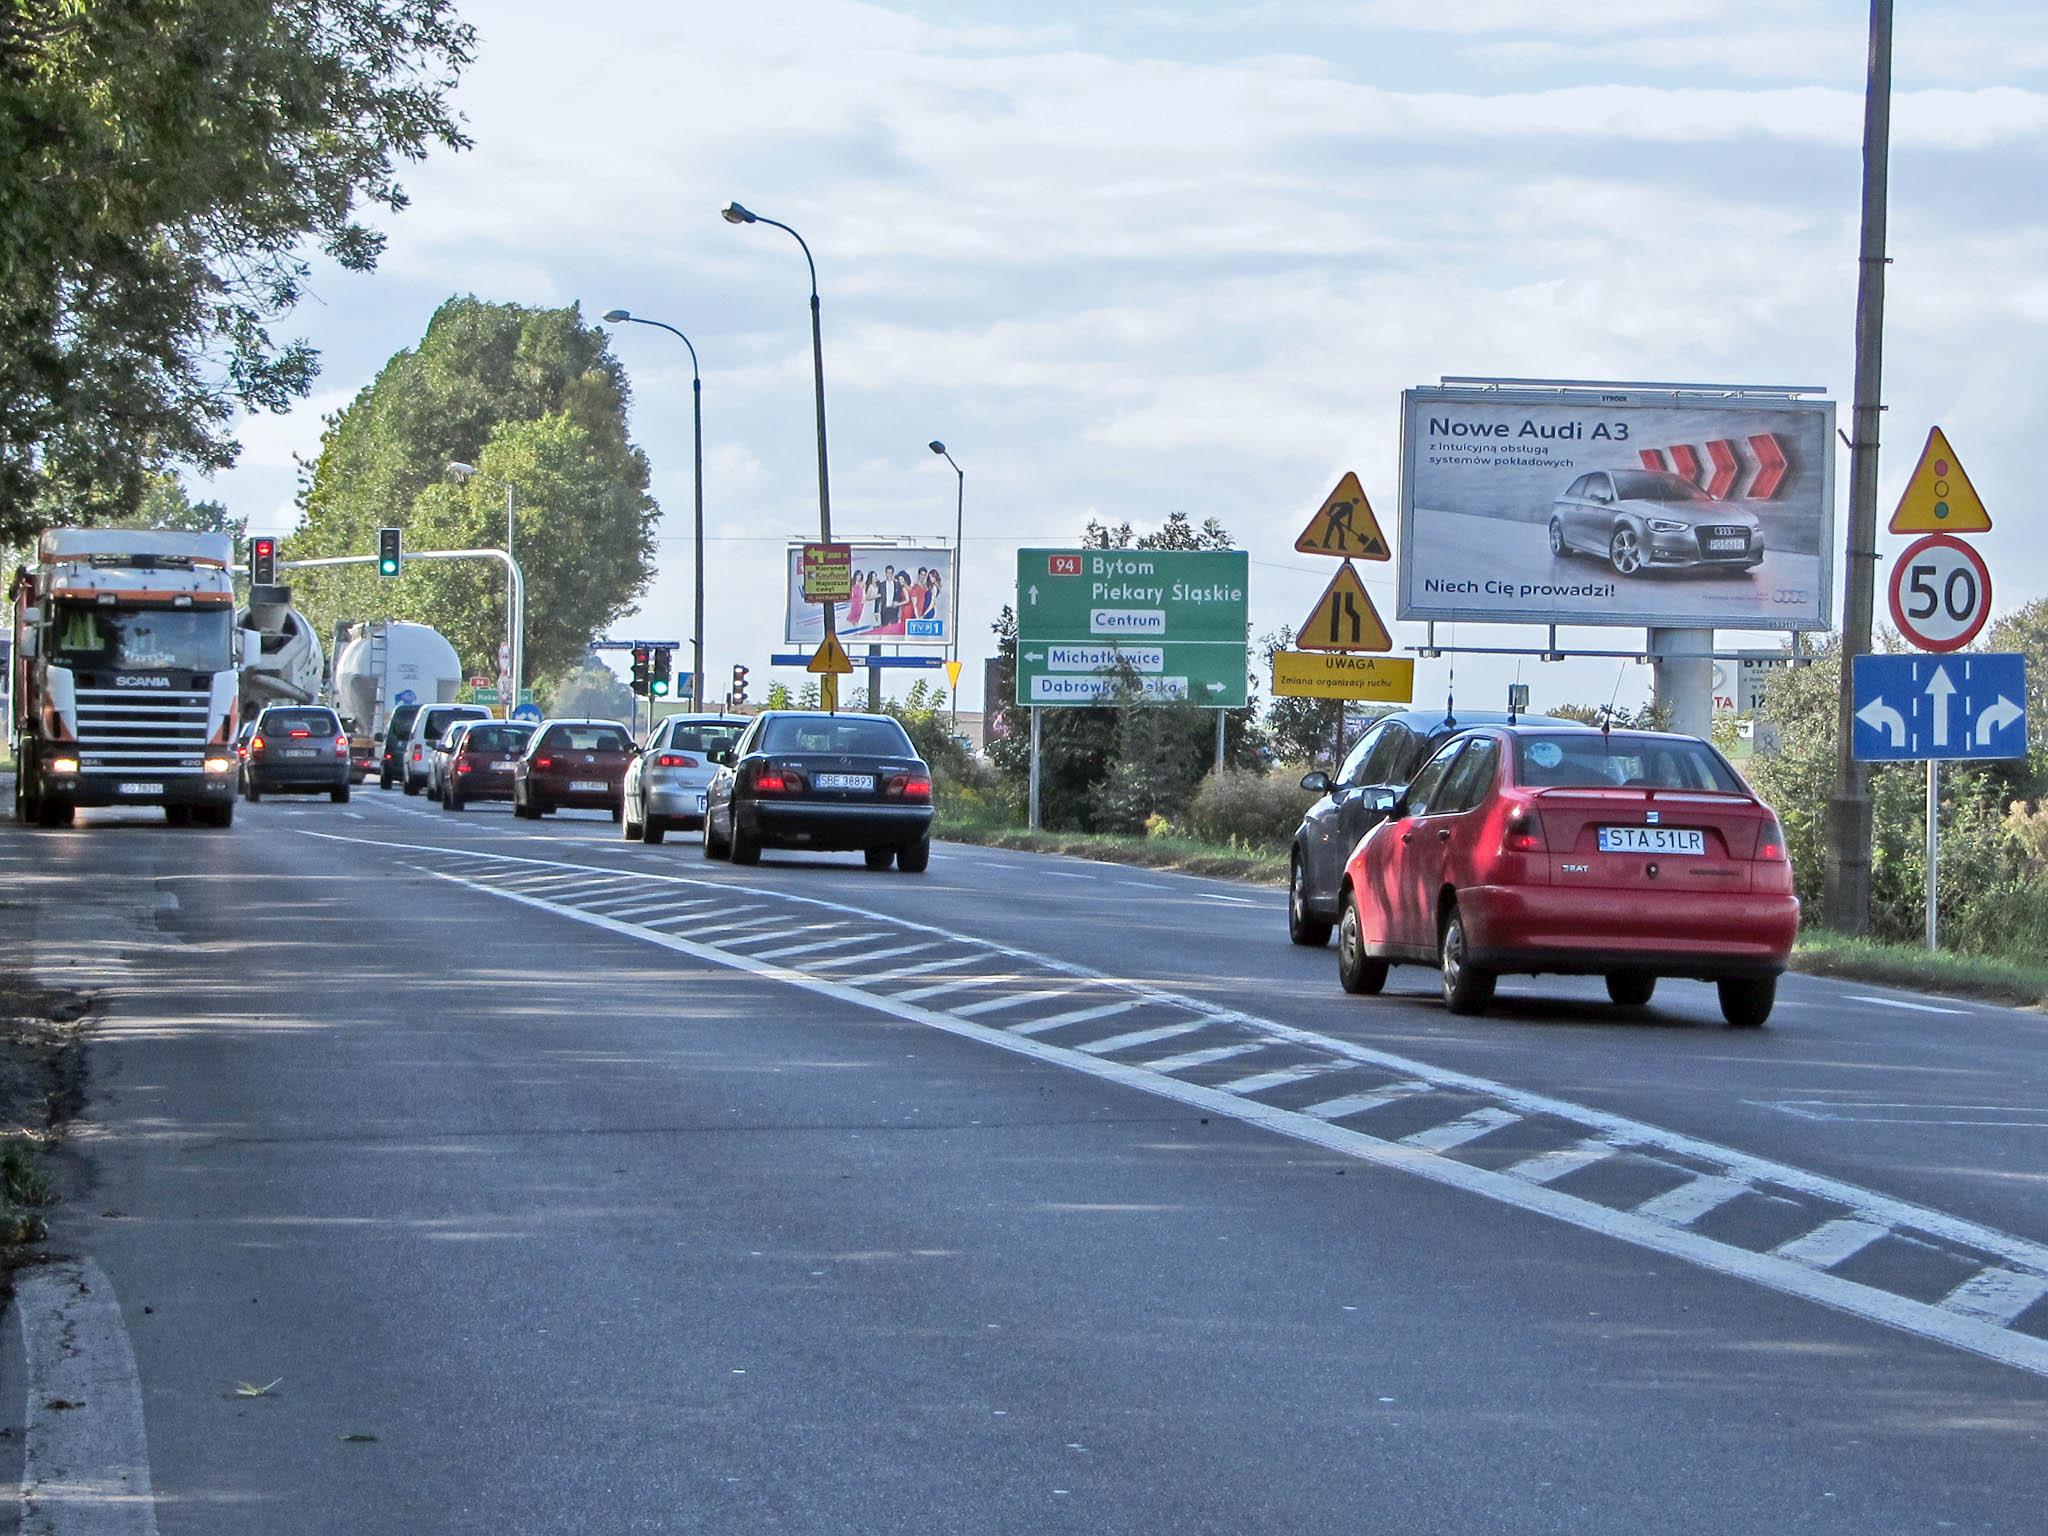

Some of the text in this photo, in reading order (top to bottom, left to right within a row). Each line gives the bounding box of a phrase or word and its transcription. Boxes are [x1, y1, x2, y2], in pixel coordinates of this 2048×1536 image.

[1430, 417, 1629, 441] Nowe Audi A3
[1439, 442, 1497, 454] intuicyjną
[1500, 445, 1549, 456] obsługą
[1429, 456, 1574, 469] systemów pokładowych
[1056, 557, 1154, 579] 94 Bytom
[1092, 578, 1242, 605] Piekary Śląskie
[1424, 579, 1616, 598] Niech Cię prowadzi!
[1908, 565, 1976, 621] 50
[1095, 612, 1160, 627] Centrum
[1052, 650, 1160, 664] Michałkwice
[1326, 658, 1376, 670] UWAGA
[116, 676, 171, 688] SCANIA
[1280, 675, 1392, 689] Zmiana organizacji ruchu
[821, 775, 872, 787] SBE 38893
[1610, 829, 1700, 849] STA 51LR
